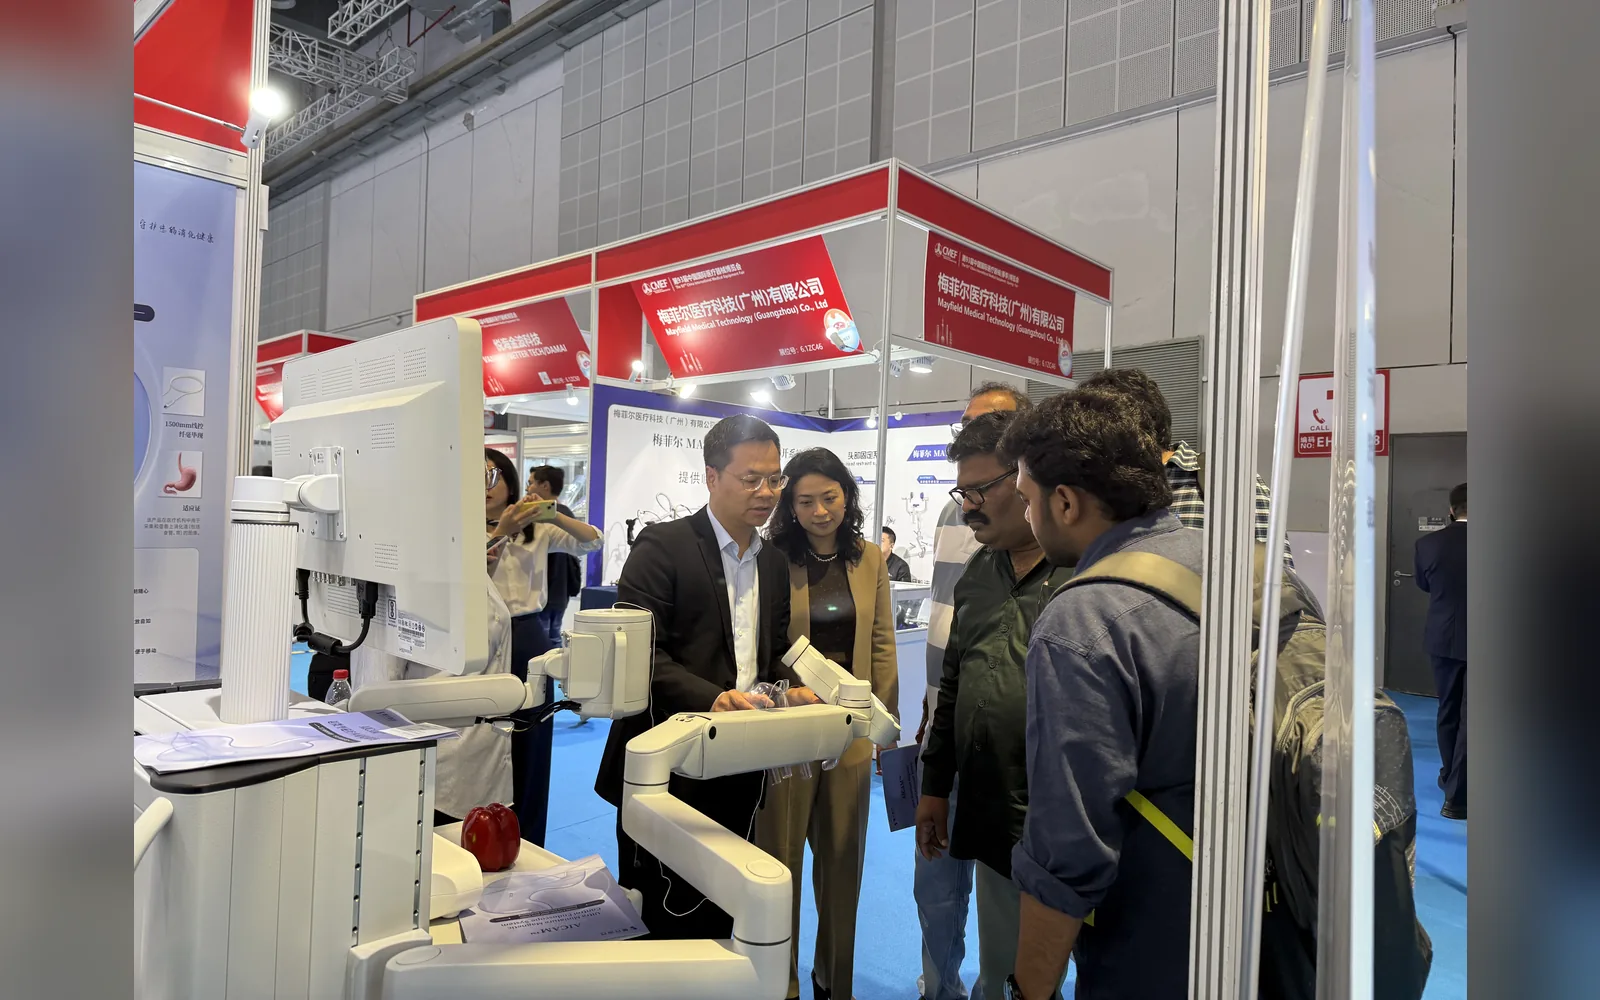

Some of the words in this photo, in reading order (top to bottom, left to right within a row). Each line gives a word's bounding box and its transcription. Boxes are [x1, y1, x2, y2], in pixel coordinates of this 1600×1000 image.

[942, 245, 958, 260] CMEF
[650, 278, 668, 291] CMEF
[656, 276, 825, 326] 梅菲尔医疗科技(广州)有限公司
[665, 324, 692, 337] Mayfield
[691, 316, 716, 332] Medical
[715, 309, 754, 328] Technology
[753, 304, 800, 323] (Guangzhou)
[799, 302, 815, 313] Co.,
[814, 299, 829, 310] Ltd
[937, 297, 963, 314] Mayfield
[963, 305, 986, 322] Medical
[986, 313, 1016, 333] Technology
[1015, 324, 1046, 342] (Guangzhou)
[1046, 333, 1056, 345] Co.,
[652, 433, 683, 448] 梅菲尔
[506, 921, 544, 930] Magnetic
